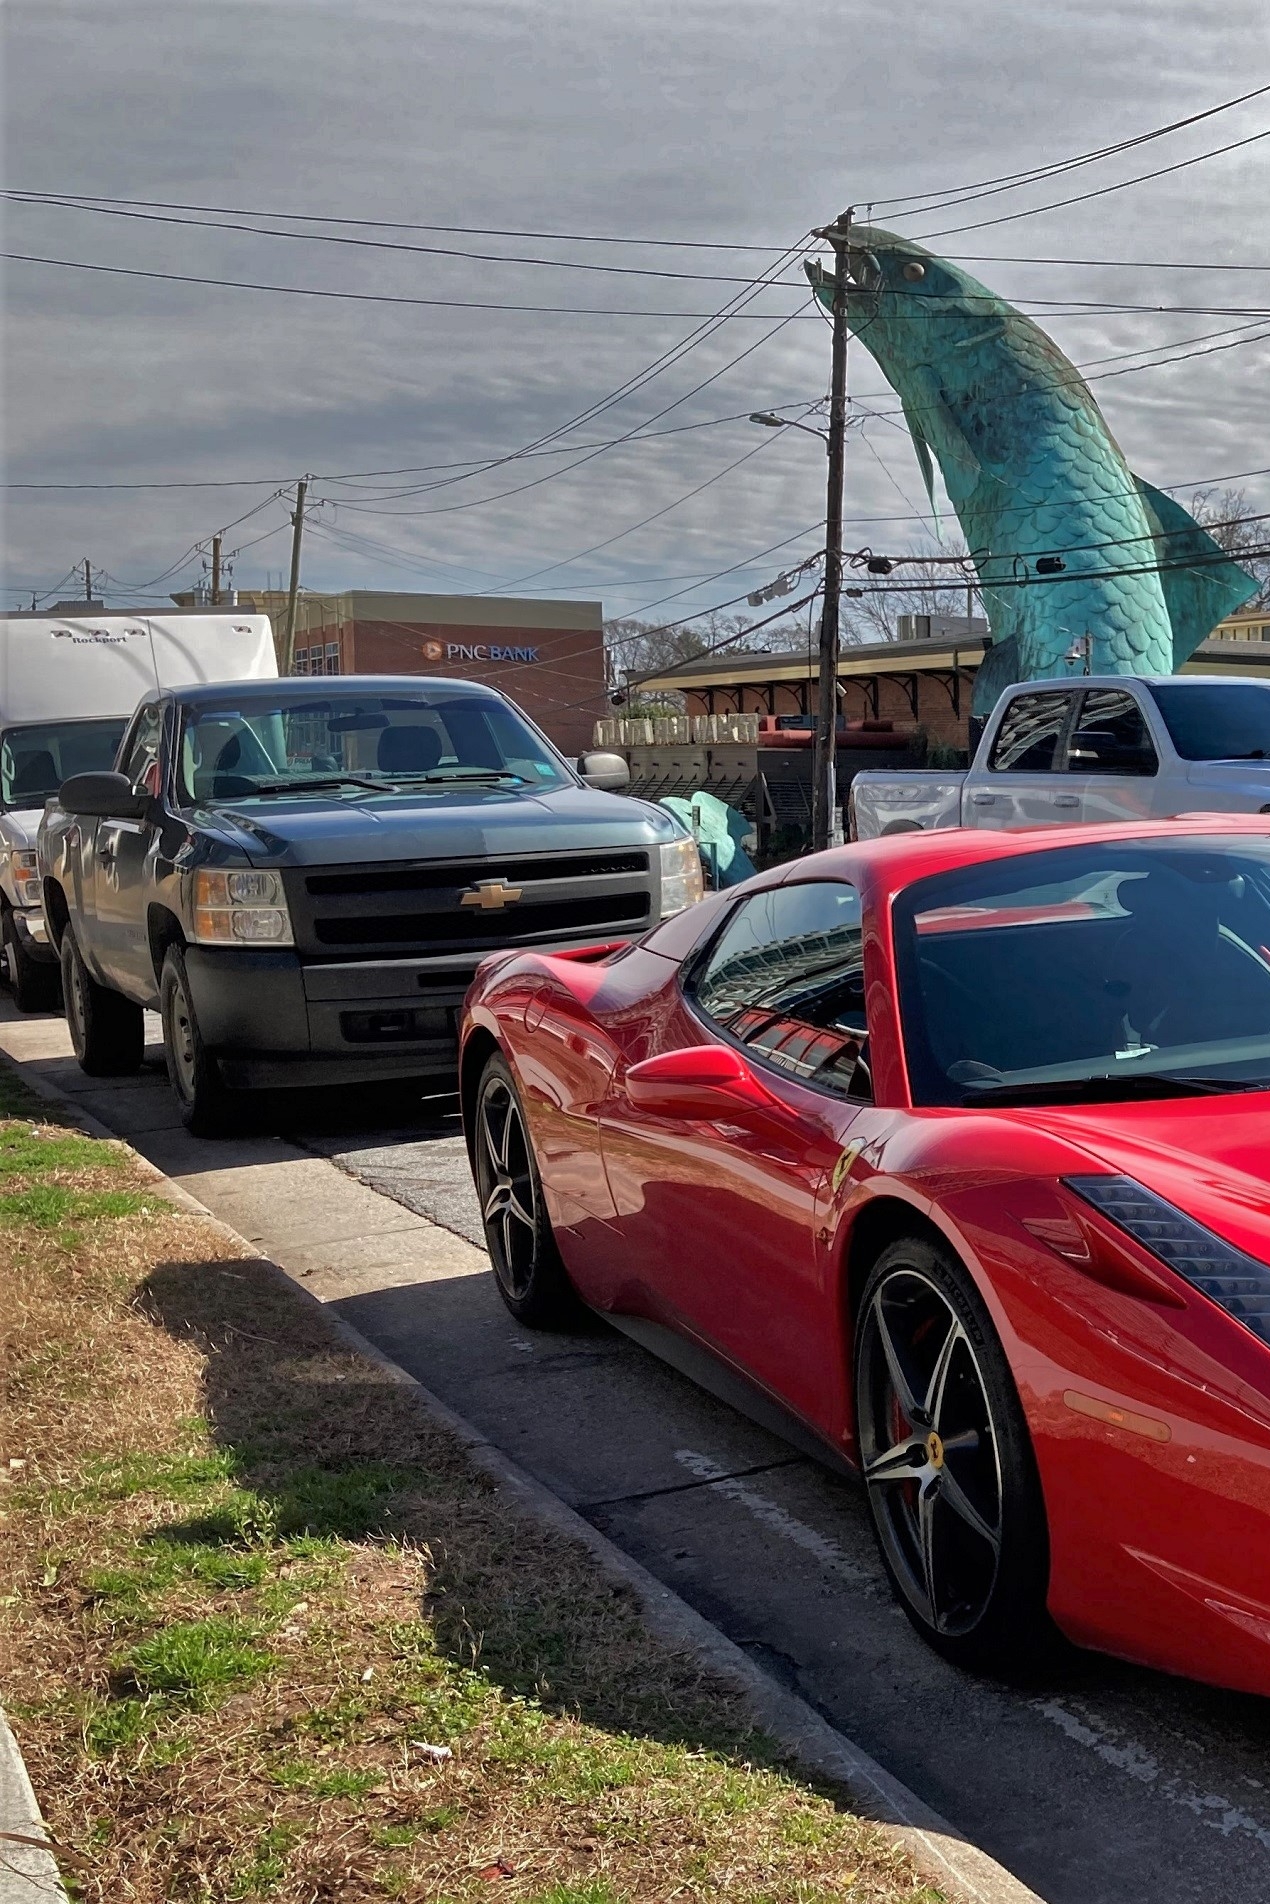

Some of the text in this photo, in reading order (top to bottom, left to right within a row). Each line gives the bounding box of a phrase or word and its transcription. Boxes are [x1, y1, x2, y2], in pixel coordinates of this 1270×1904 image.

[72, 636, 127, 644] Rockport
[446, 643, 540, 661] PNC BANK
